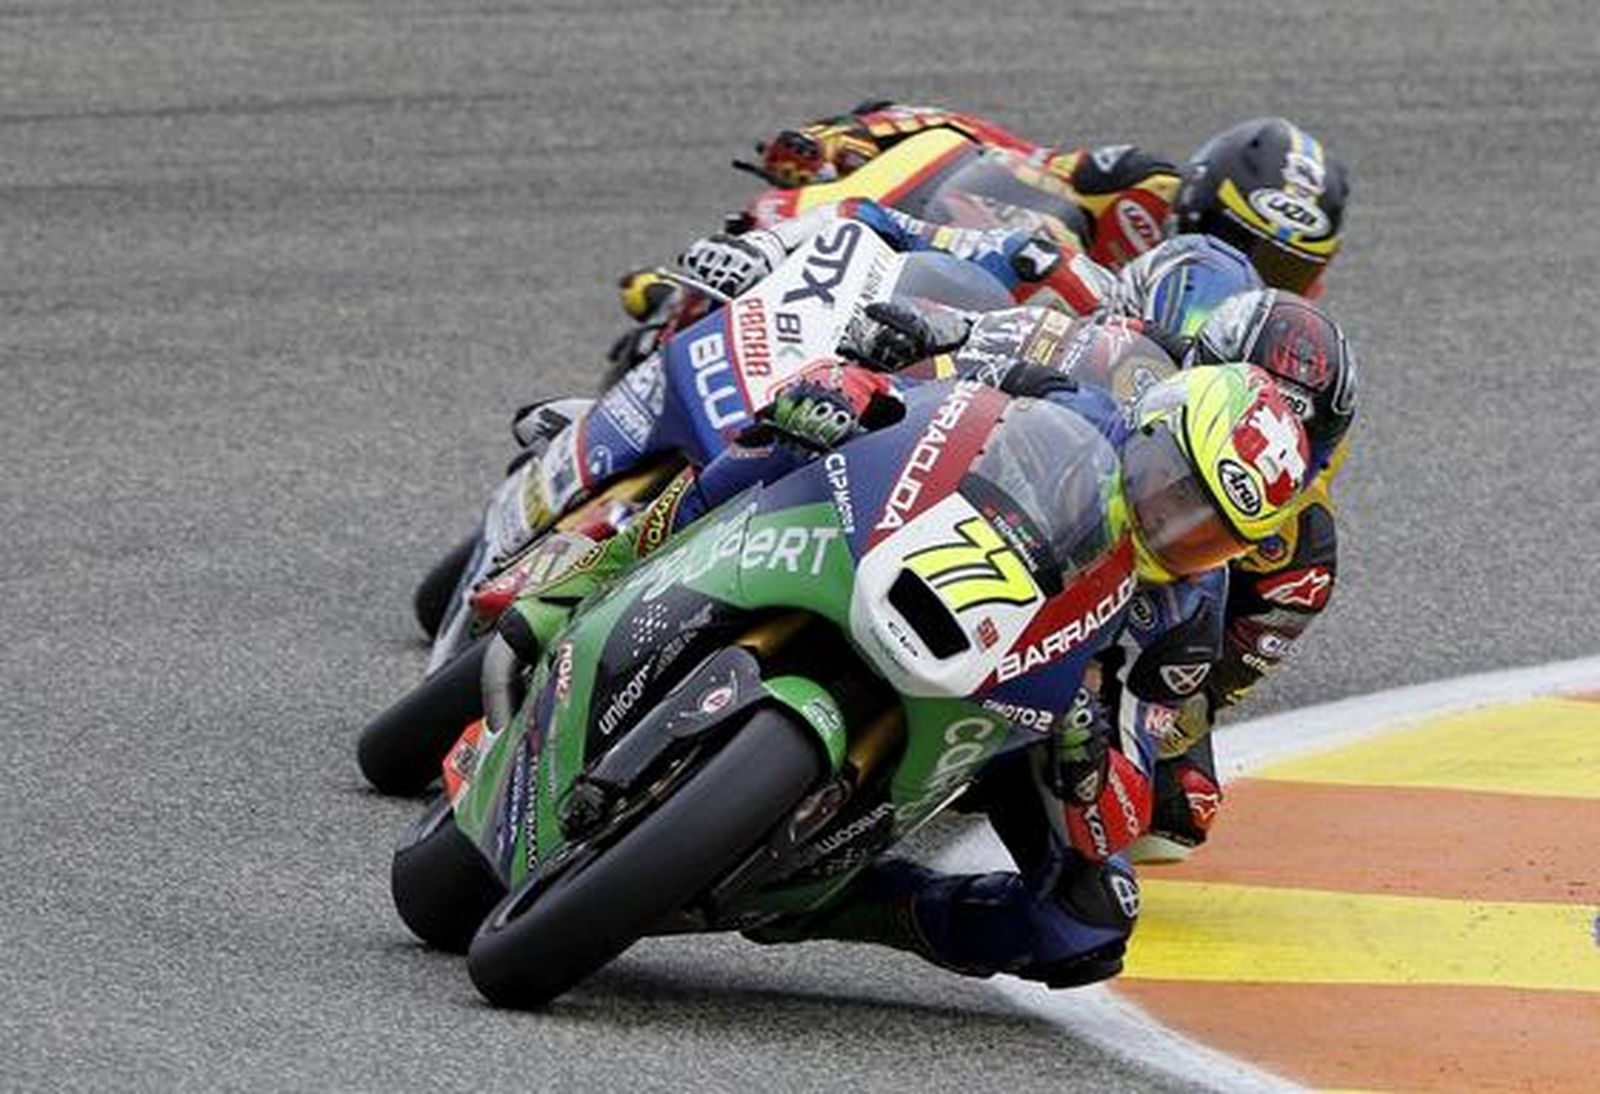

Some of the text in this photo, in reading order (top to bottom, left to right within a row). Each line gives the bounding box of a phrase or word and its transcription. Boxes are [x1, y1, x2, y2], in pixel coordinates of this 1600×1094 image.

[783, 223, 862, 305] STX
[688, 332, 749, 429] BLU
[903, 516, 1039, 614] 77
